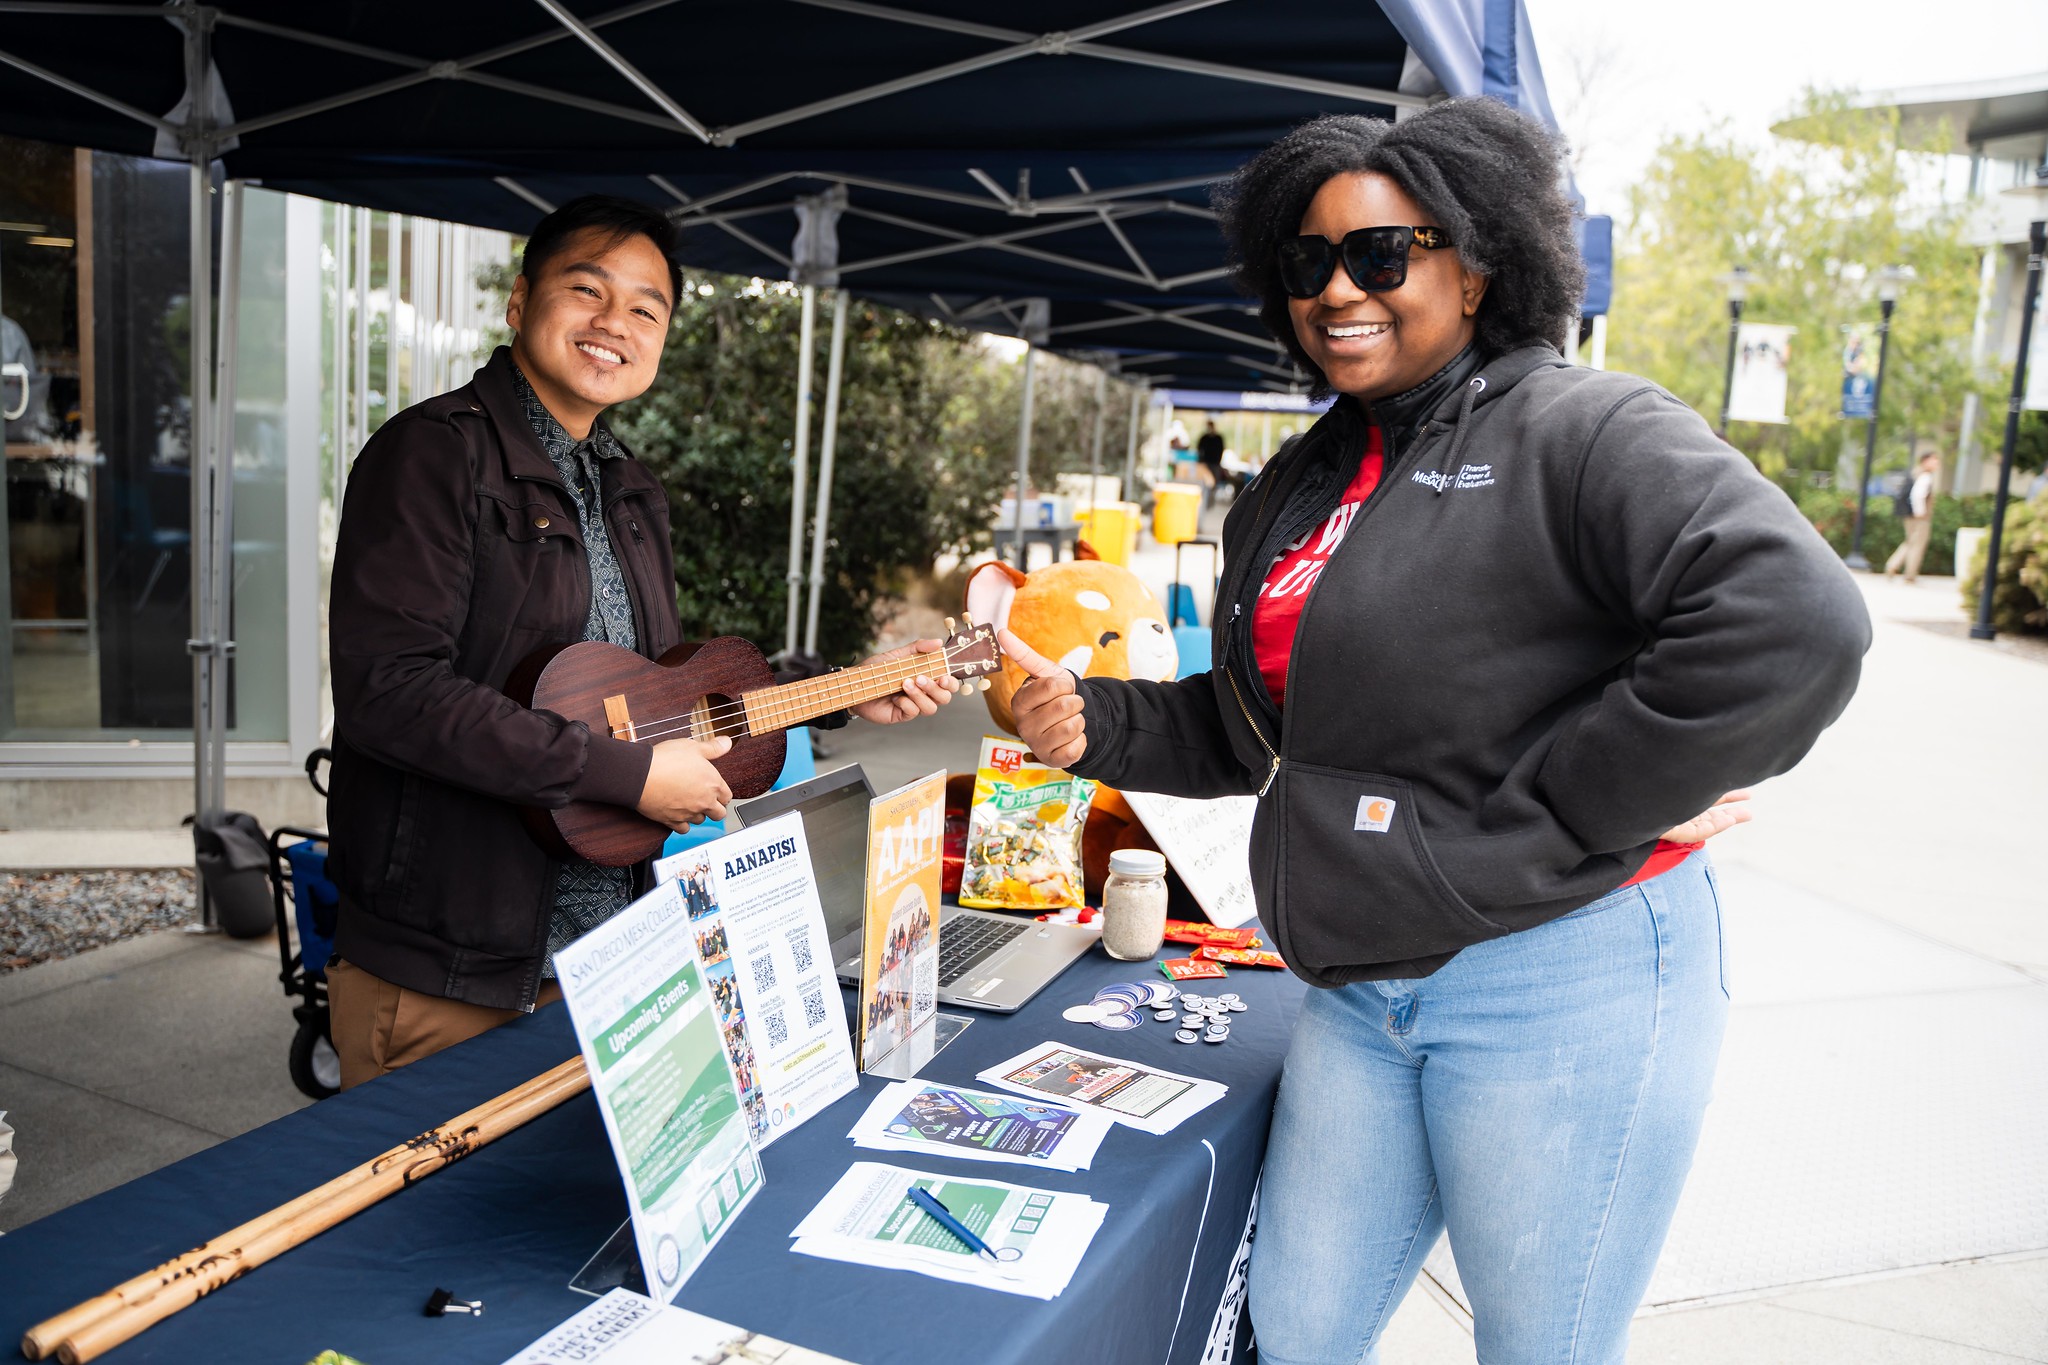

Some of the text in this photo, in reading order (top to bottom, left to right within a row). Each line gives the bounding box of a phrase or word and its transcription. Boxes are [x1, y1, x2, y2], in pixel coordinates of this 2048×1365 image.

[1457, 478, 1495, 488] Evaluations
[1461, 471, 1484, 480] Career
[1465, 464, 1492, 472] Transfer
[725, 837, 796, 879] AANAPISI
[876, 802, 939, 886] AAPI
[591, 938, 624, 972] DIEGO
[622, 923, 648, 948] MESA
[646, 896, 680, 932] COLLEGE
[608, 980, 689, 1053] Upcoming Events
[884, 1202, 915, 1233] Upcoming
[548, 1332, 588, 1358] THEY
[588, 1299, 639, 1333] CALLED
[569, 1342, 597, 1360] US
[594, 1303, 652, 1344] ENEMY
